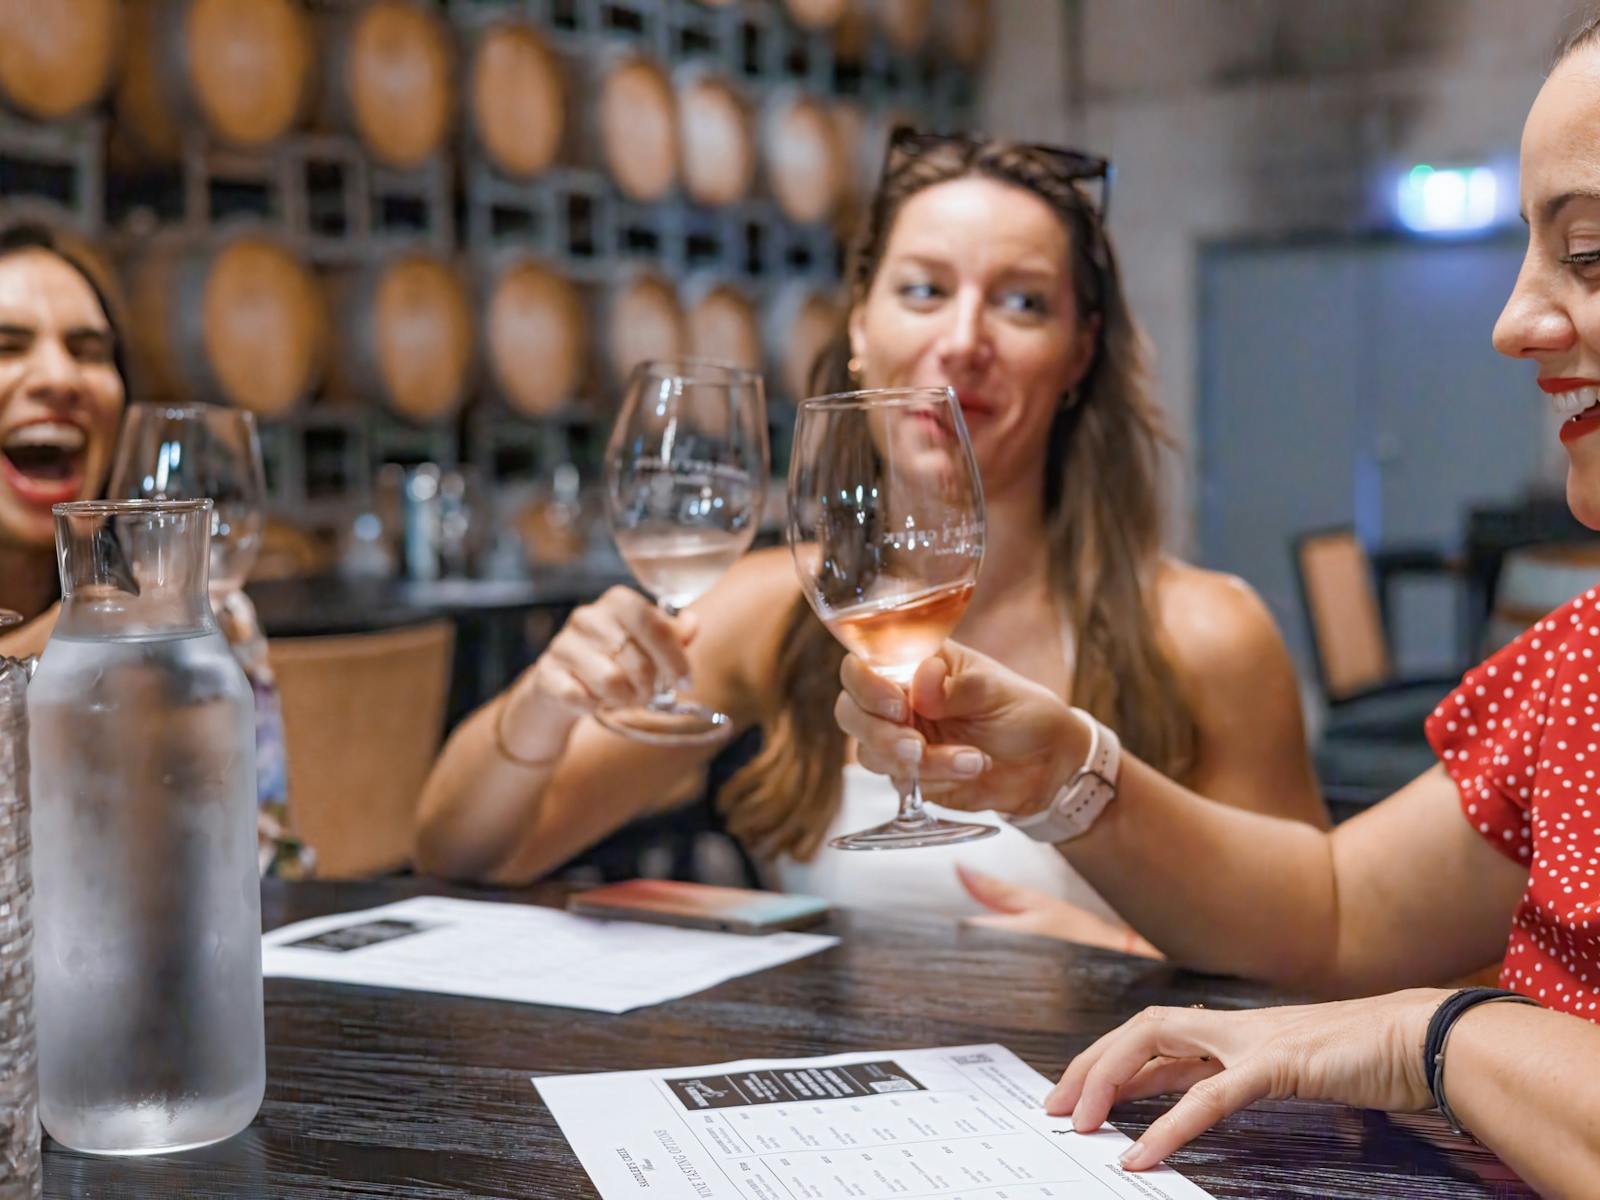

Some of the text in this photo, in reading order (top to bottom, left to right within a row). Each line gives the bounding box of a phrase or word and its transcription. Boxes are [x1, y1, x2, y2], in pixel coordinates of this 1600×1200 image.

[616, 1147, 650, 1188] SADDLER'S CREEK
[653, 1129, 713, 1199] WINE TASTING OPTIONS
